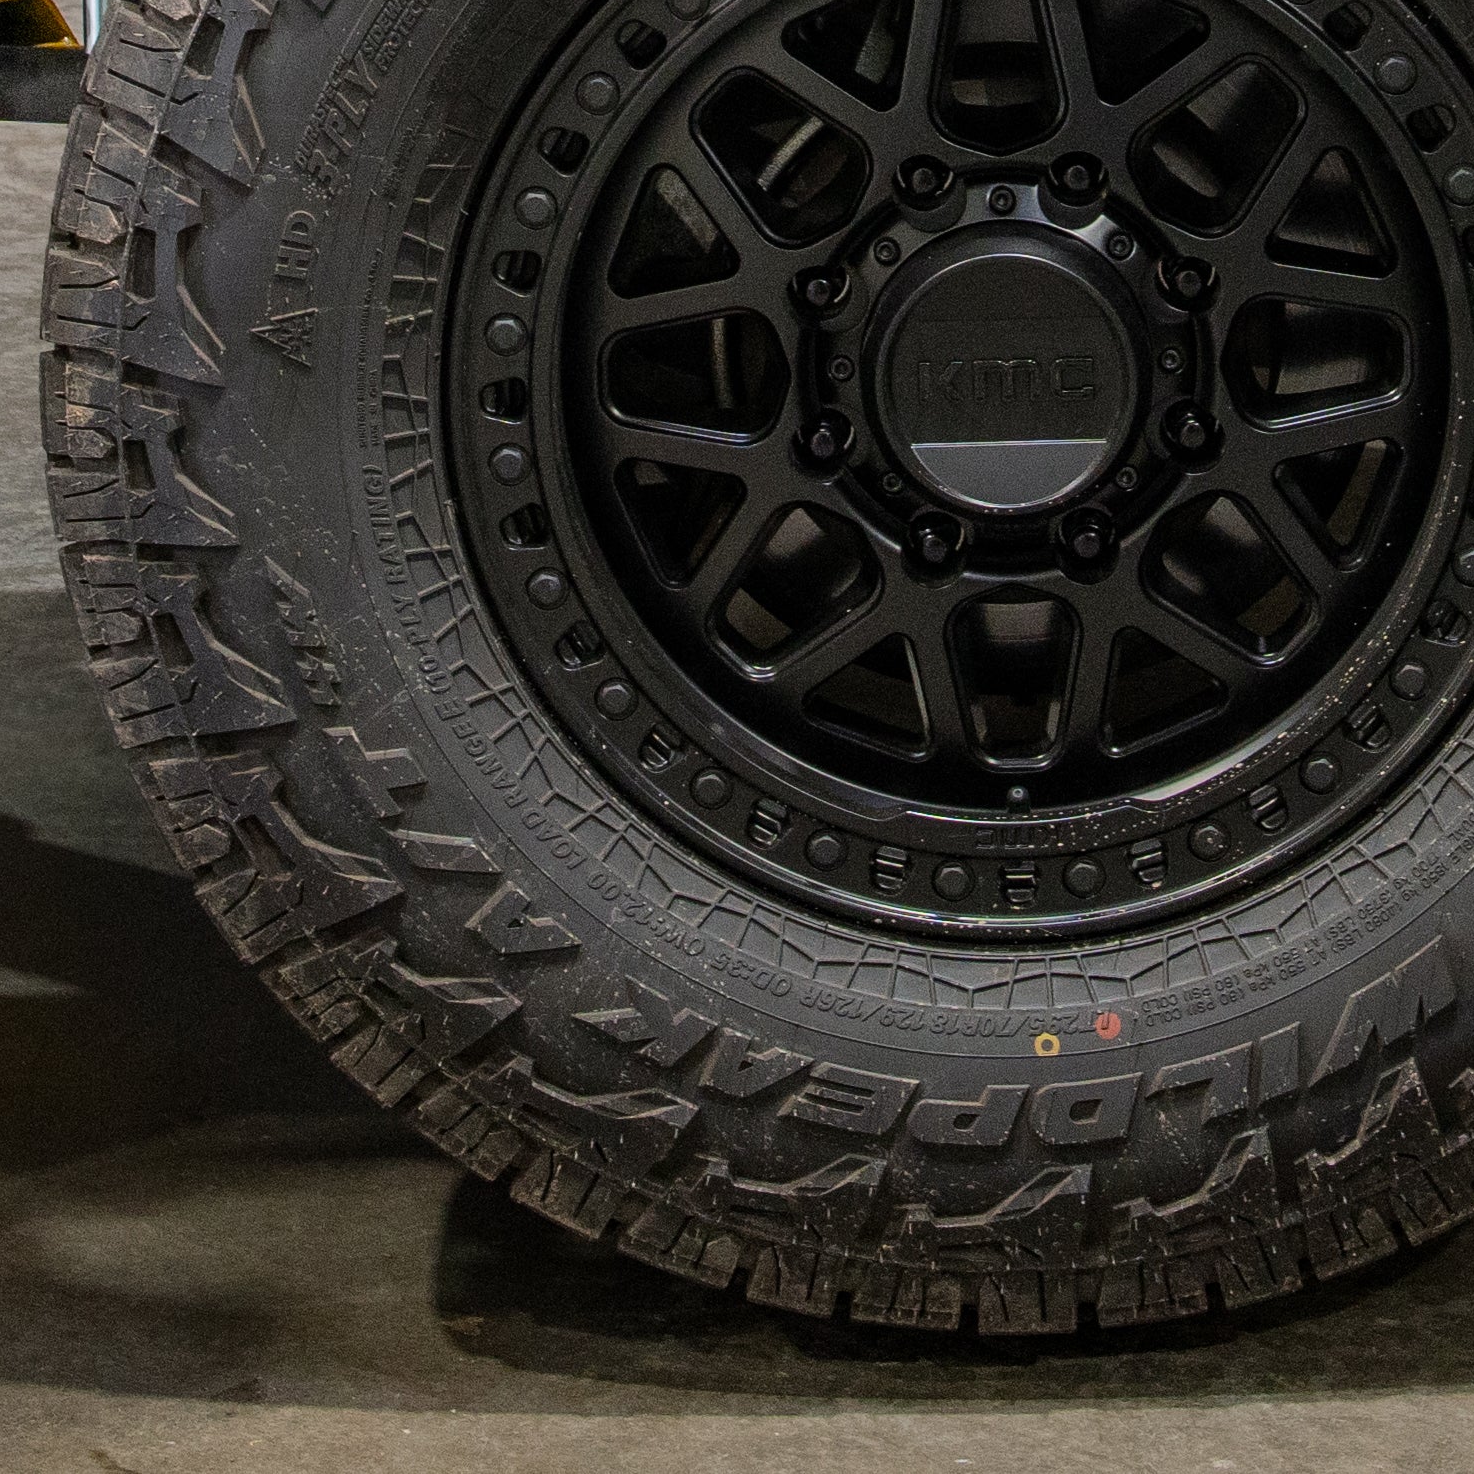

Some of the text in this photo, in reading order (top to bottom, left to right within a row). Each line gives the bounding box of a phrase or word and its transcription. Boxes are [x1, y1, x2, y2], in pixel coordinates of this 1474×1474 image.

[306, 58, 384, 188] 3-PLY
[273, 209, 319, 279] HD
[363, 465, 409, 590] RATING)
[391, 593, 453, 700] (10-PLY
[436, 699, 469, 731] E
[459, 723, 529, 811] RANGE
[521, 806, 586, 872] LOAD
[805, 990, 932, 1033] 129/126R
[935, 1009, 1112, 1038] LT295/70R18
[1140, 991, 1180, 1012] COLD
[1144, 1004, 1182, 1025] COLD
[573, 935, 1458, 1148] WILDPEAK
